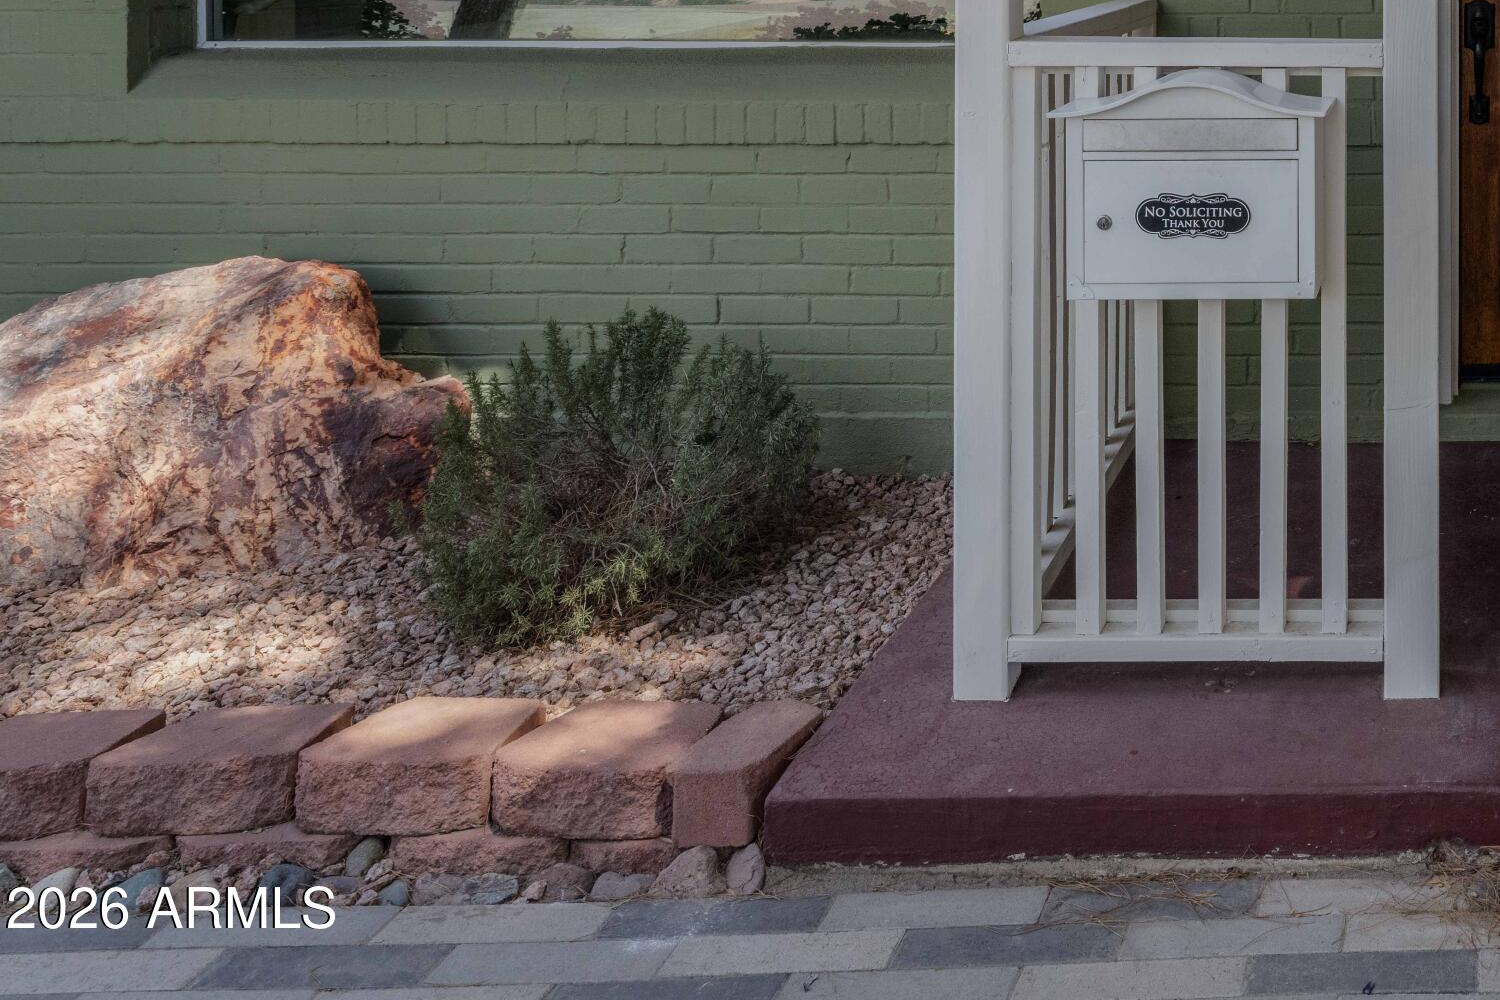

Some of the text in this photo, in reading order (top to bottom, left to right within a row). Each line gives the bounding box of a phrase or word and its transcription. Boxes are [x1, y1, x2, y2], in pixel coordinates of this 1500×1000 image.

[1144, 205, 1243, 218] NO SOLICITING
[1161, 218, 1225, 228] THANK YOU
